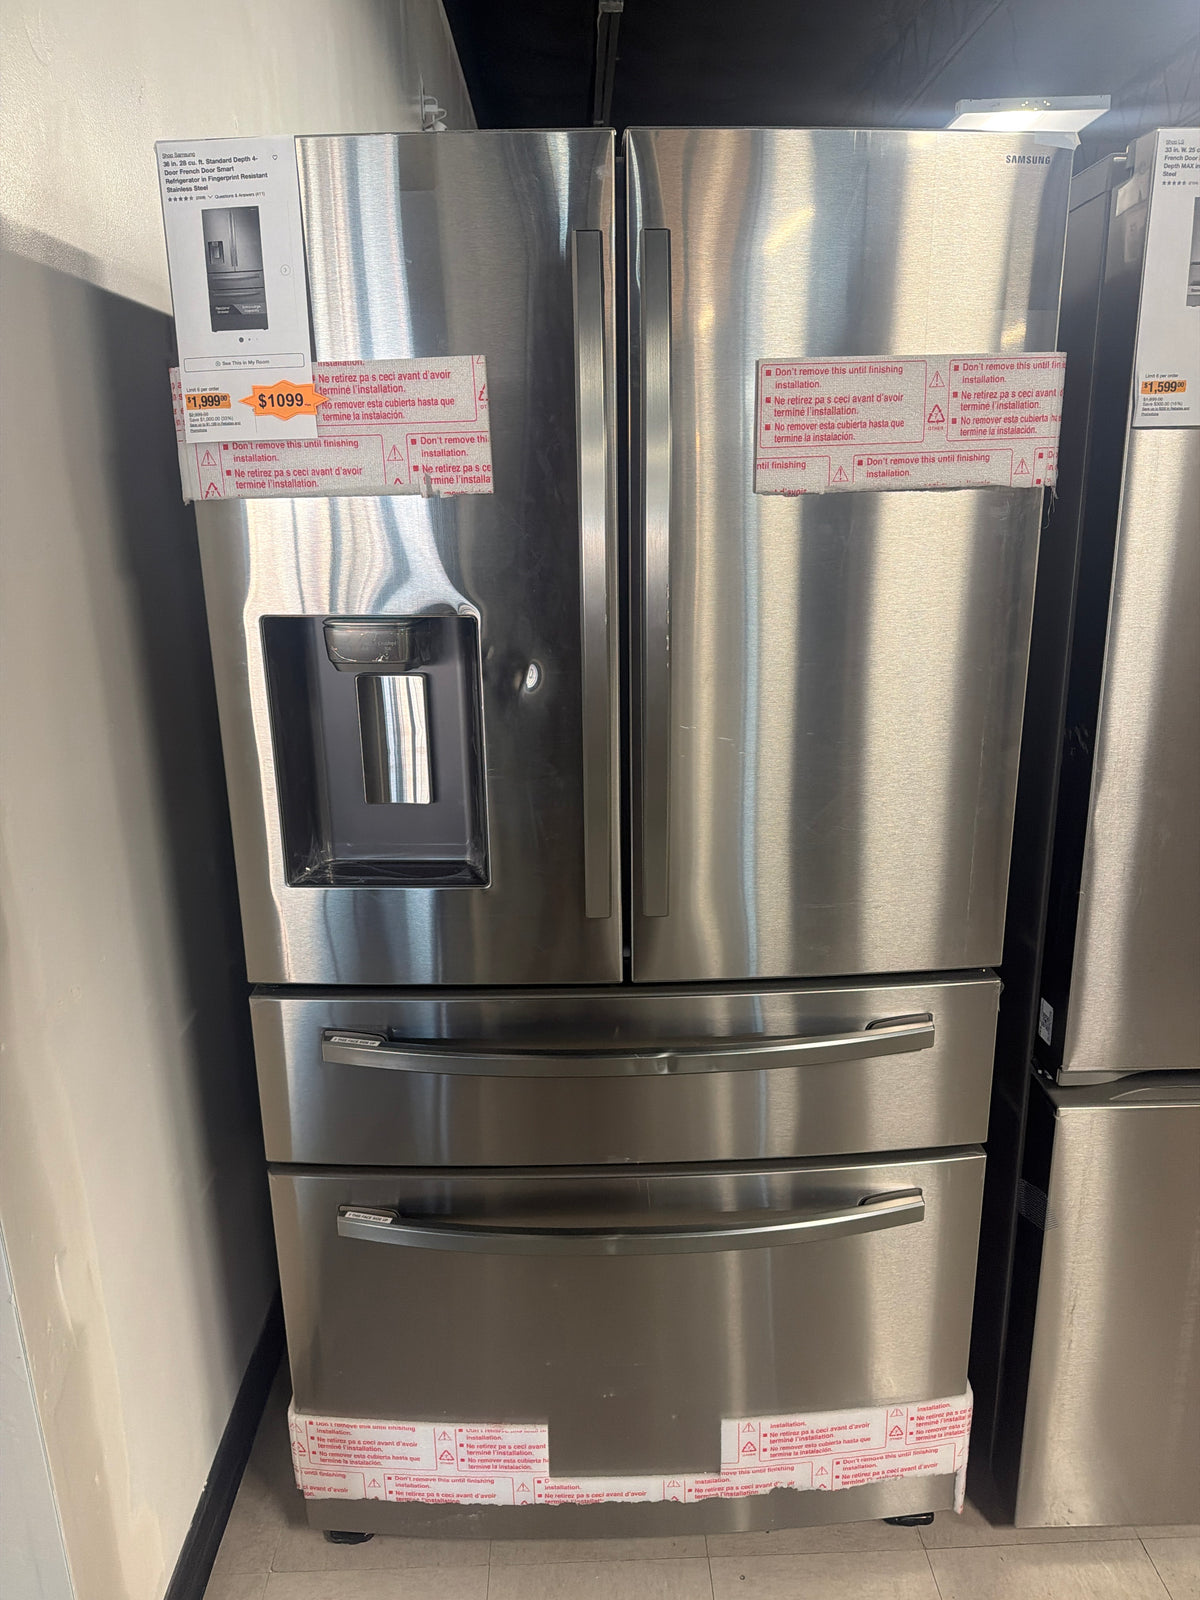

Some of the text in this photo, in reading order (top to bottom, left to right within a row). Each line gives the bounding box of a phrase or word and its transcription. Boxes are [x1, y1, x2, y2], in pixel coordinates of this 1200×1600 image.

[1006, 155, 1051, 165] SAMSUNG
[208, 175, 239, 183] Fingerprint
[775, 368, 797, 376] Don't
[868, 365, 903, 375] finishing
[962, 363, 984, 371] Don't
[1016, 362, 1031, 370] this
[318, 370, 451, 384] Ne retirez pa s ceci avant d'avoir
[962, 376, 1006, 384] installation.
[352, 384, 405, 394] l'installation.
[775, 381, 822, 389] installation.
[774, 396, 786, 405] Ne
[787, 397, 813, 405] retirez
[814, 397, 826, 406] pa
[833, 396, 851, 404] ceci
[852, 395, 875, 403] avant
[876, 393, 903, 402] d'avoir
[961, 391, 972, 400] Ne
[973, 391, 998, 399] retirez
[999, 392, 1010, 400] pa
[1011, 391, 1017, 399] s
[1035, 389, 1056, 397] avant
[258, 392, 304, 409] $1099
[334, 401, 365, 409] remover
[366, 400, 383, 408] esta
[384, 399, 416, 408] cubierta
[417, 398, 439, 406] hasta
[440, 398, 455, 407] que
[992, 401, 1041, 410] l'installation.
[322, 412, 405, 421] termine la instalación.
[806, 407, 859, 416] l'installation.
[960, 417, 971, 425] No
[972, 417, 1002, 425] remover
[1003, 416, 1019, 424] esta
[774, 423, 785, 431] No
[787, 423, 817, 431] remover
[836, 421, 867, 429] cubierta
[890, 421, 904, 429] que
[420, 436, 443, 445] Don't
[774, 433, 856, 443] termine la instalación.
[232, 442, 254, 450] Don't
[323, 439, 359, 449] finishing
[421, 449, 469, 457] installation.
[866, 457, 889, 466] Don't
[920, 456, 936, 464] this
[938, 455, 956, 463] until
[956, 454, 990, 463] finishing
[234, 469, 246, 478] Ne
[247, 469, 272, 478] retirez
[274, 470, 285, 478] pa
[292, 469, 309, 477] ceci
[311, 468, 333, 476] avant
[334, 467, 362, 476] d'avoir
[866, 470, 912, 478] installation.
[268, 480, 319, 488] l'installation.
